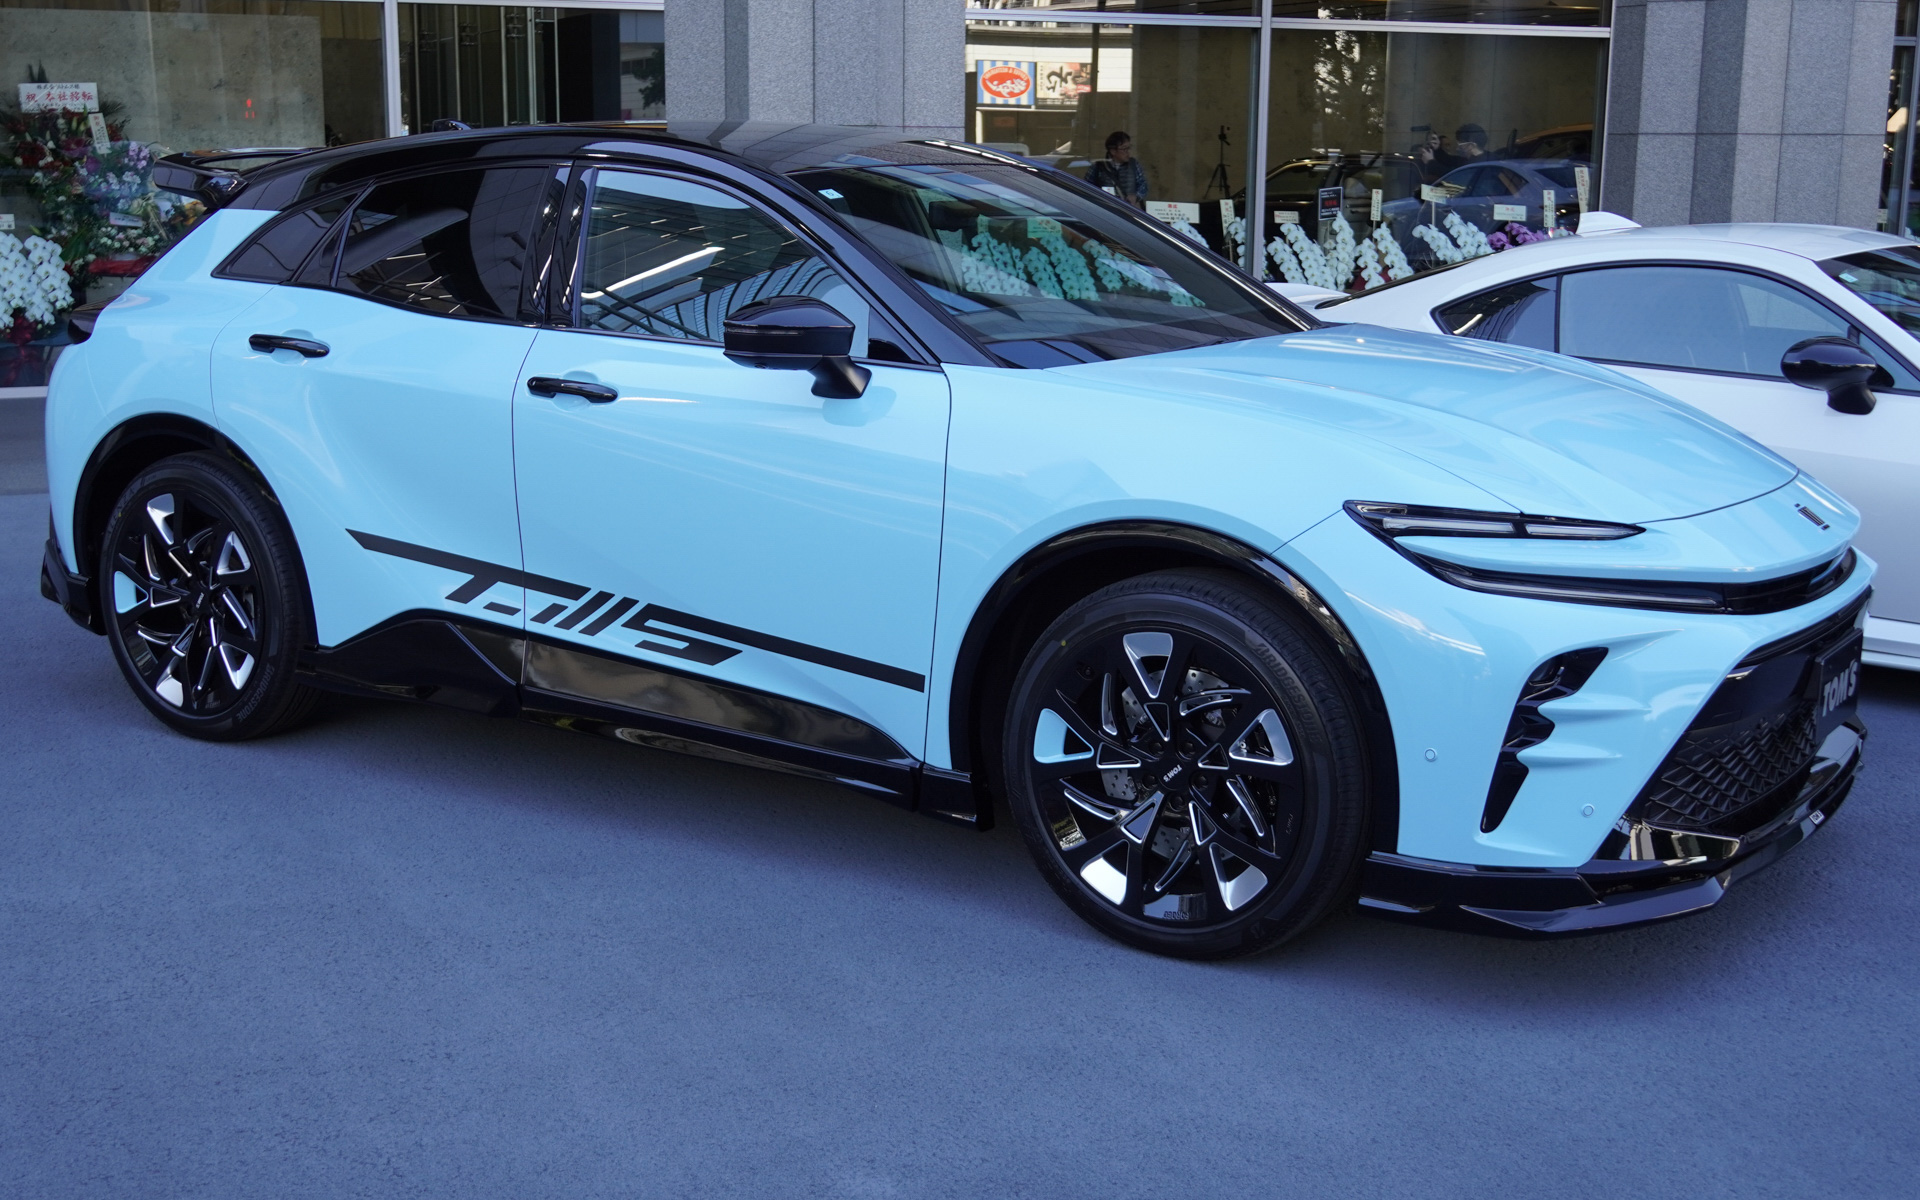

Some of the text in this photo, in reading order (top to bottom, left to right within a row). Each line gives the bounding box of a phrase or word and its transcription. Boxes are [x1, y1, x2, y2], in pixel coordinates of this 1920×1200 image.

[235, 662, 276, 723] BRIDGESTONE
[1254, 642, 1324, 743] BRIDGESTONE
[1821, 658, 1859, 718] TOM'S
